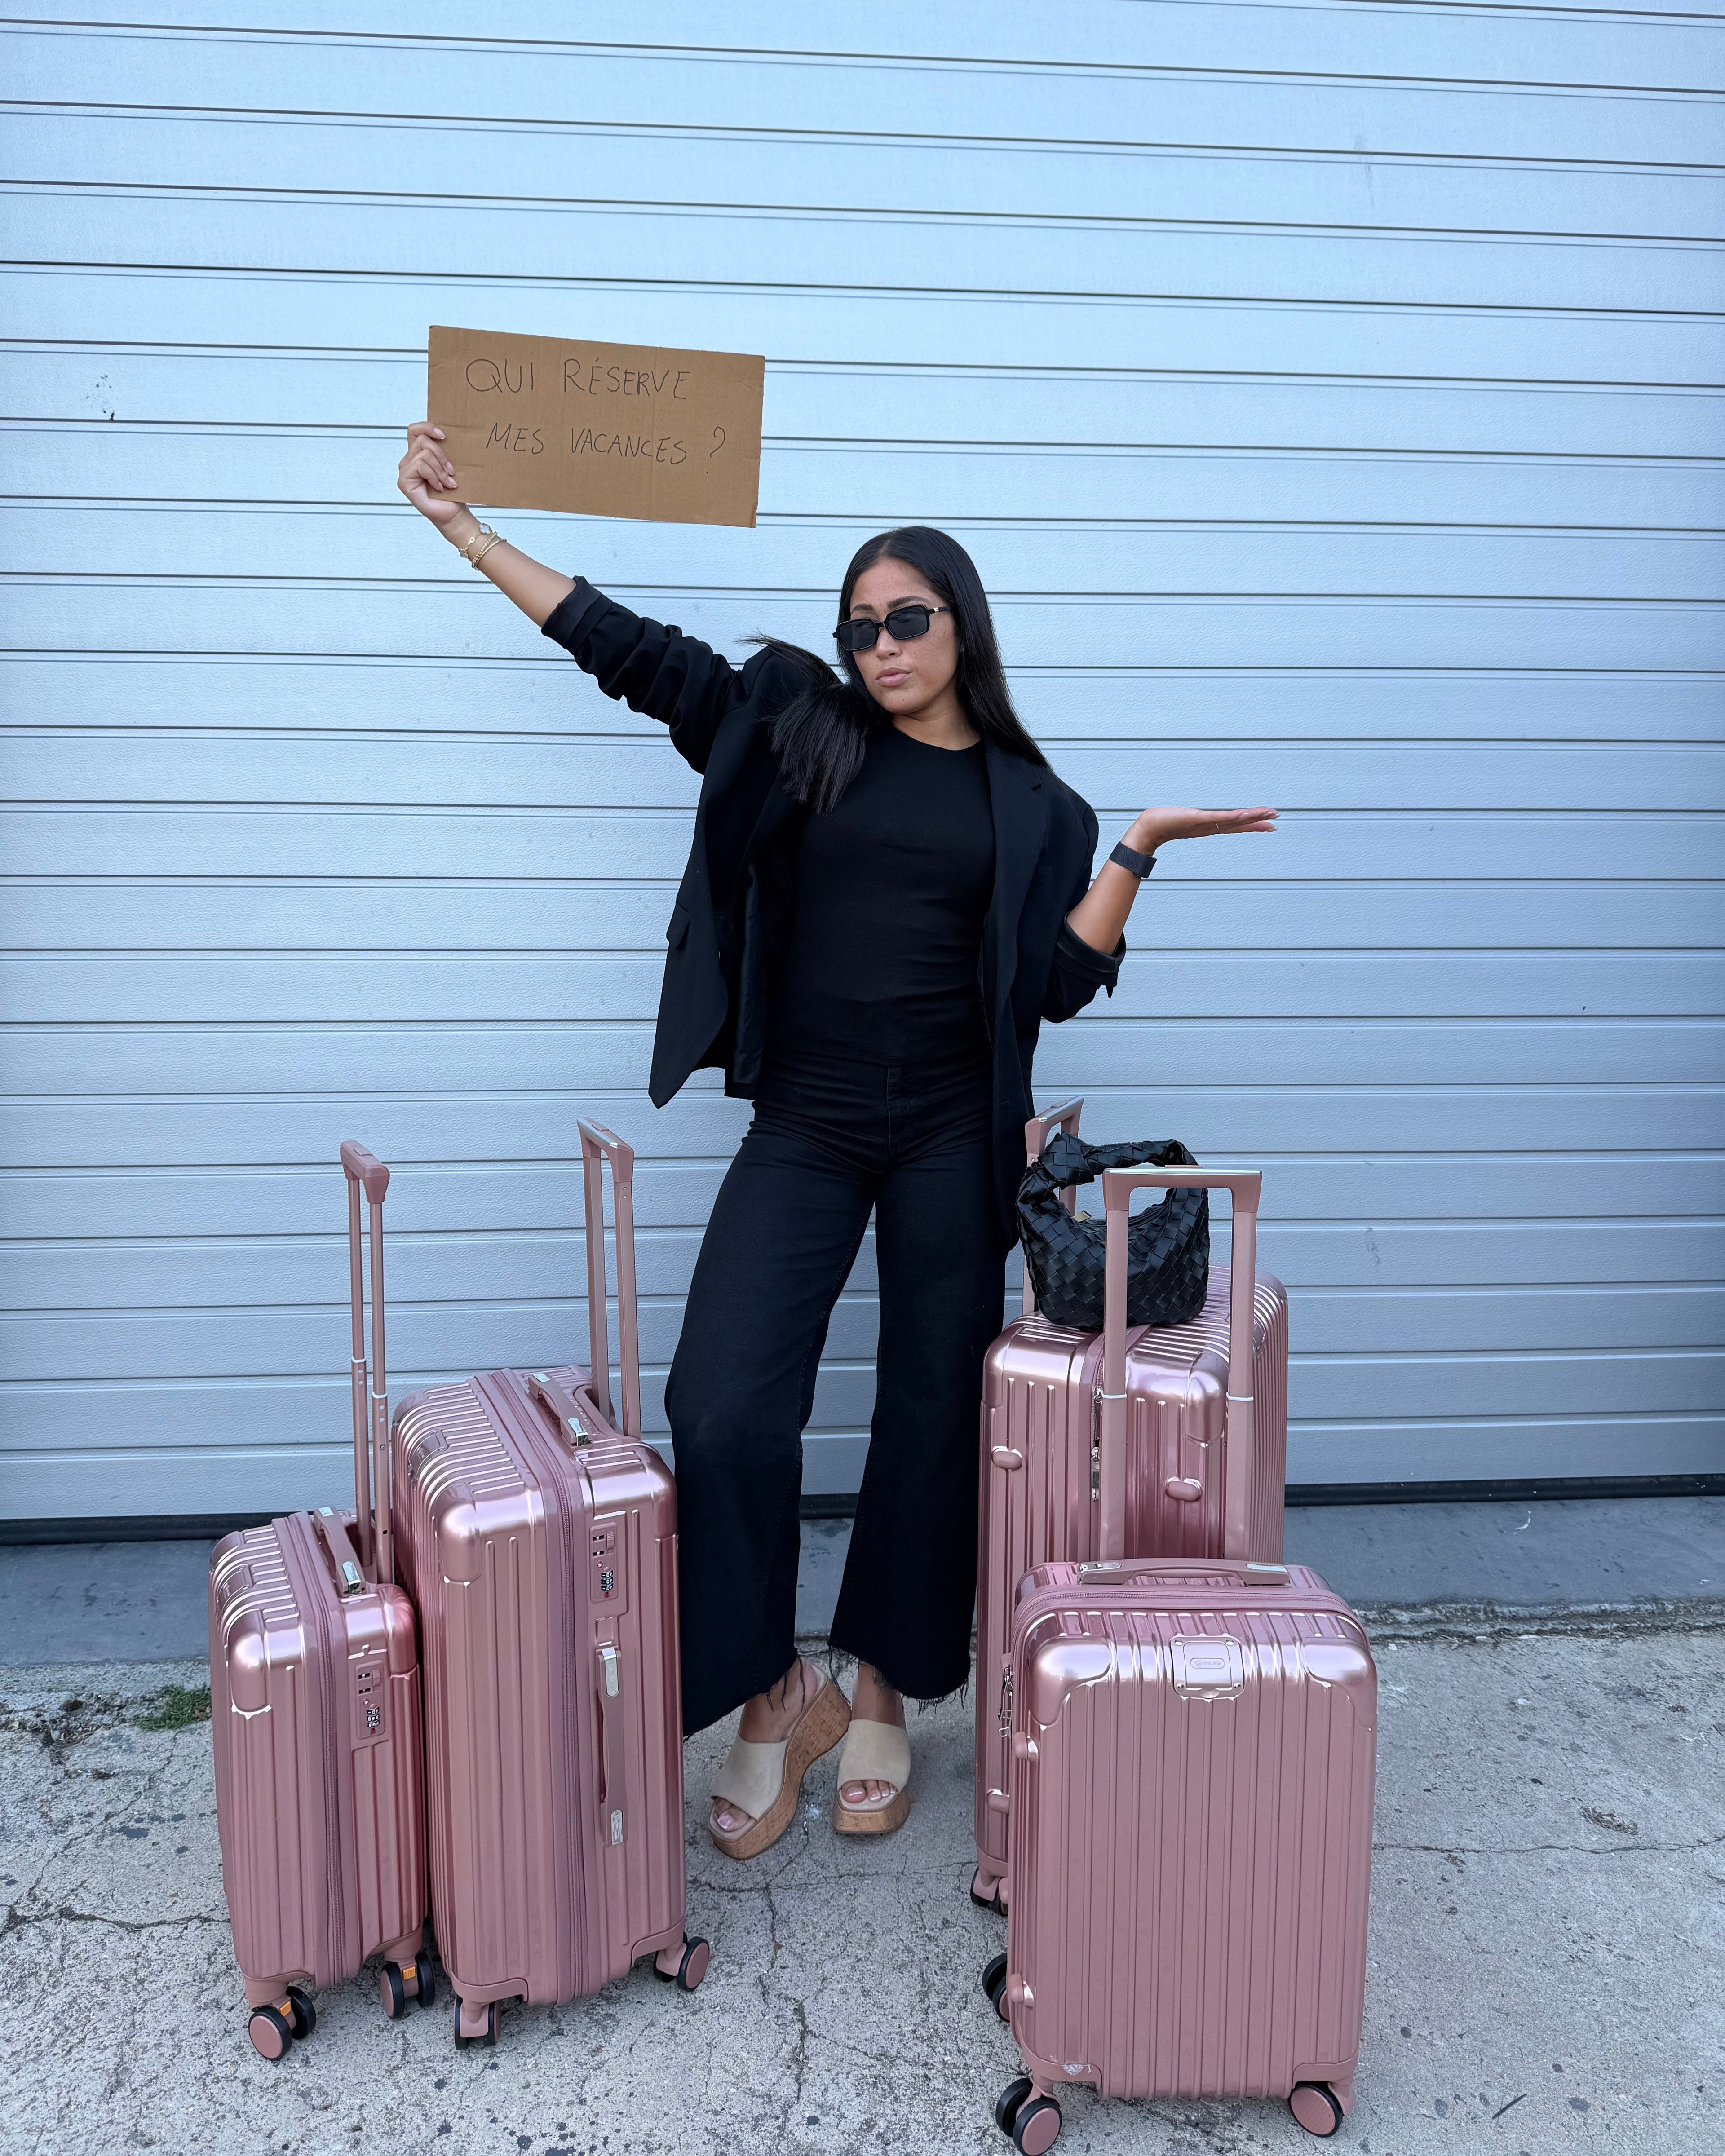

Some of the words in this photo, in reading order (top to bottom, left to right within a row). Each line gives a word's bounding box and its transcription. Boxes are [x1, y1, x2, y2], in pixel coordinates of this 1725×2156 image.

[563, 357, 690, 400] RÉSERVE
[486, 422, 544, 455] MES
[571, 427, 687, 465] VACANCES
[706, 426, 725, 474] ?
